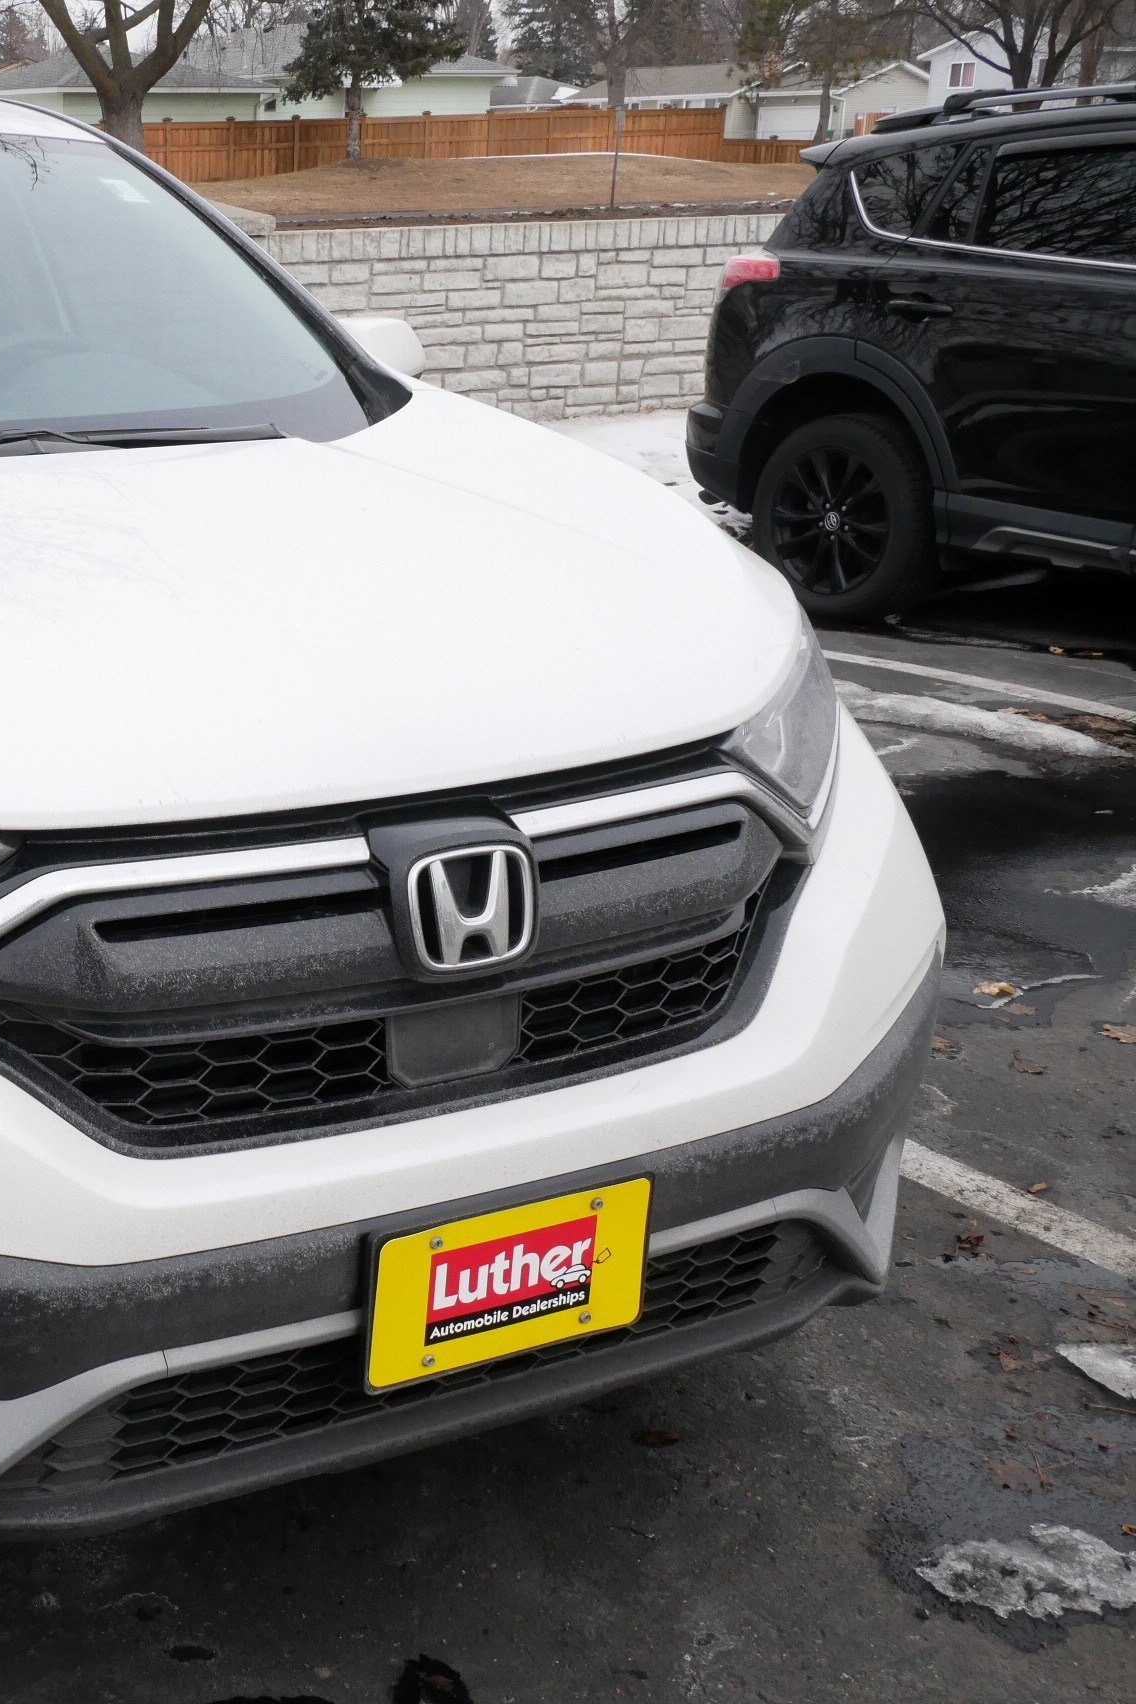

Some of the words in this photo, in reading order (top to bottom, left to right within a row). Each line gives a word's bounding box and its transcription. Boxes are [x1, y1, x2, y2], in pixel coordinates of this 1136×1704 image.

[432, 1237, 592, 1311] Luther
[429, 1309, 510, 1340] Automobile
[512, 1290, 586, 1319] Dealerships
